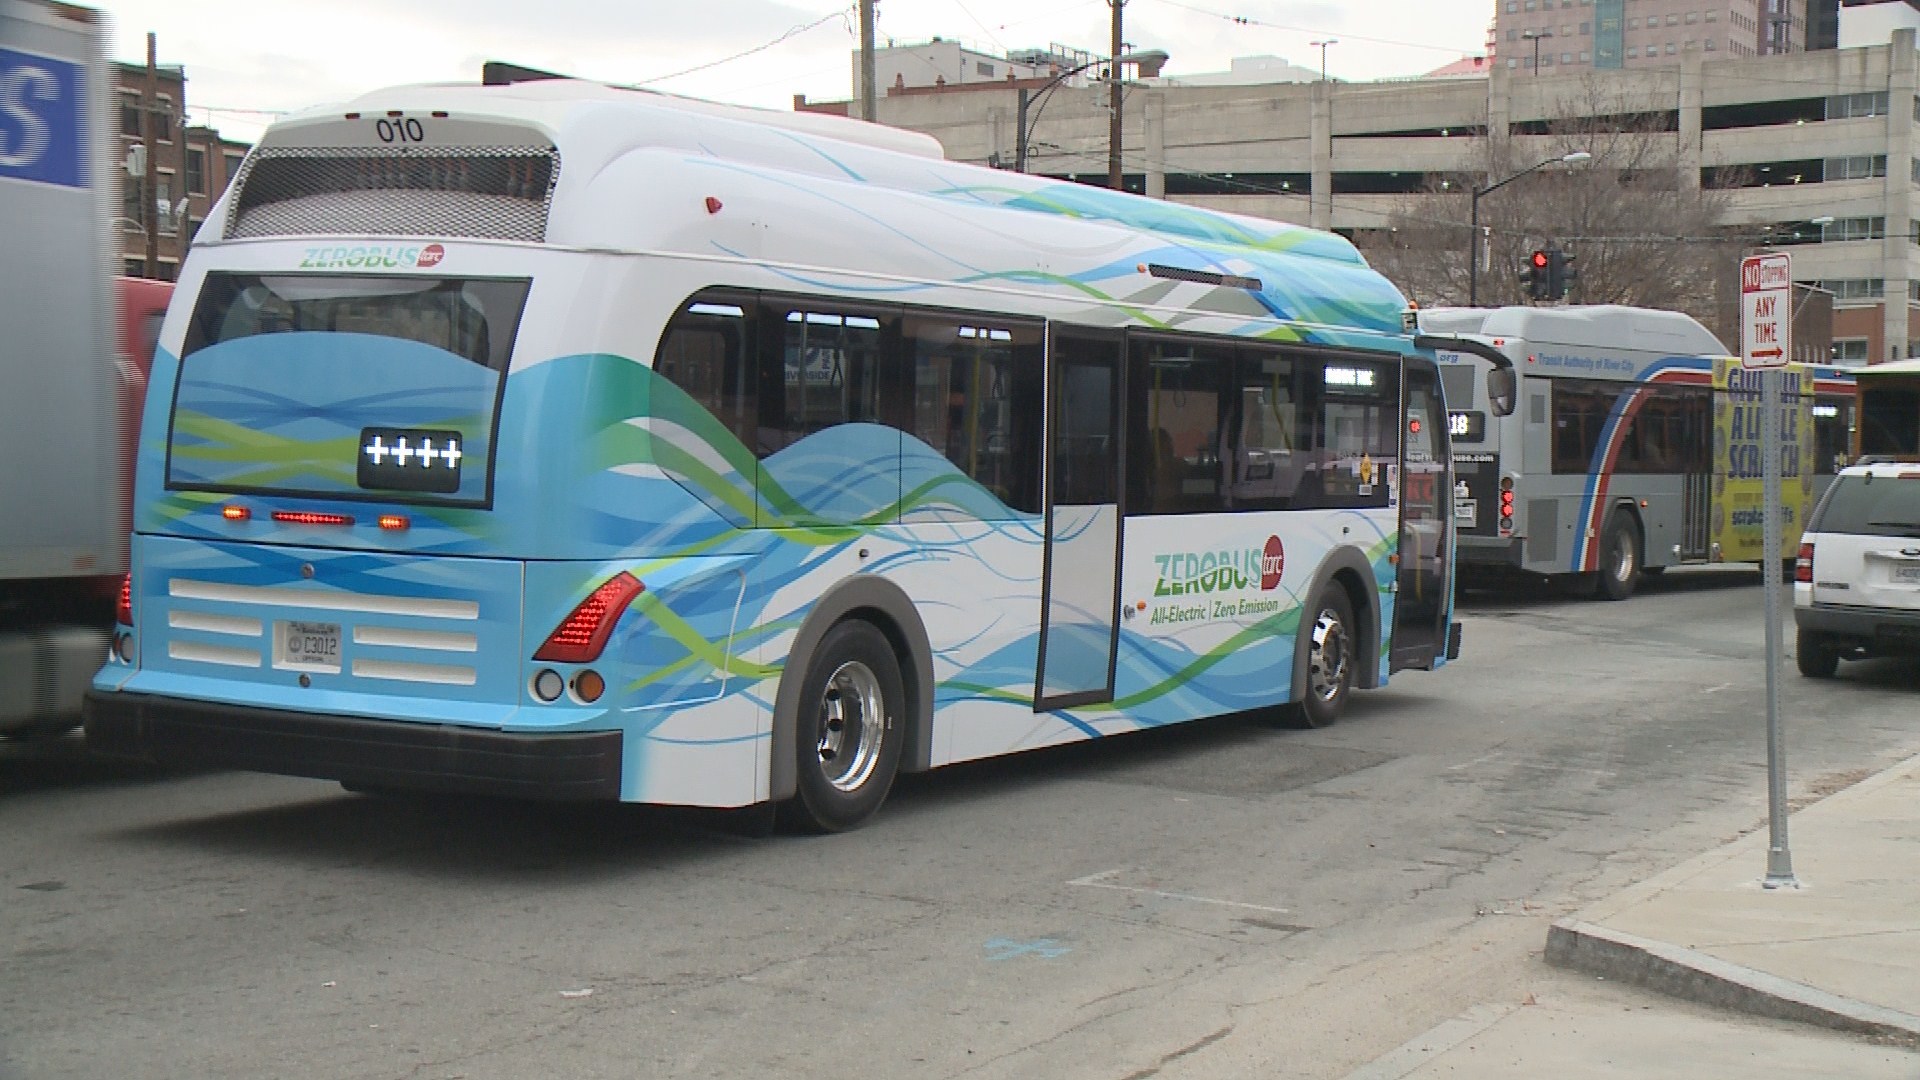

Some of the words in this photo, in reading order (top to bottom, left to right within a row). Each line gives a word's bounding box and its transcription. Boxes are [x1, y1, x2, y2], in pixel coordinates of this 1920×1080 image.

[376, 118, 424, 143] 010
[300, 246, 419, 268] ZEROBUS
[1744, 264, 1760, 288] NO
[1755, 296, 1777, 317] ANY
[1754, 322, 1778, 344] TIME
[1539, 353, 1563, 366] Transit
[1731, 406, 1744, 440] A
[1747, 407, 1798, 442] LILE
[1728, 445, 1799, 479] SCRCH
[1154, 549, 1262, 597] ZEROBUS
[1263, 553, 1283, 576] tarc
[1150, 604, 1207, 625] All-Electric
[1213, 600, 1237, 619] Zero
[1238, 597, 1279, 616] Emission
[304, 636, 337, 656] C3012
